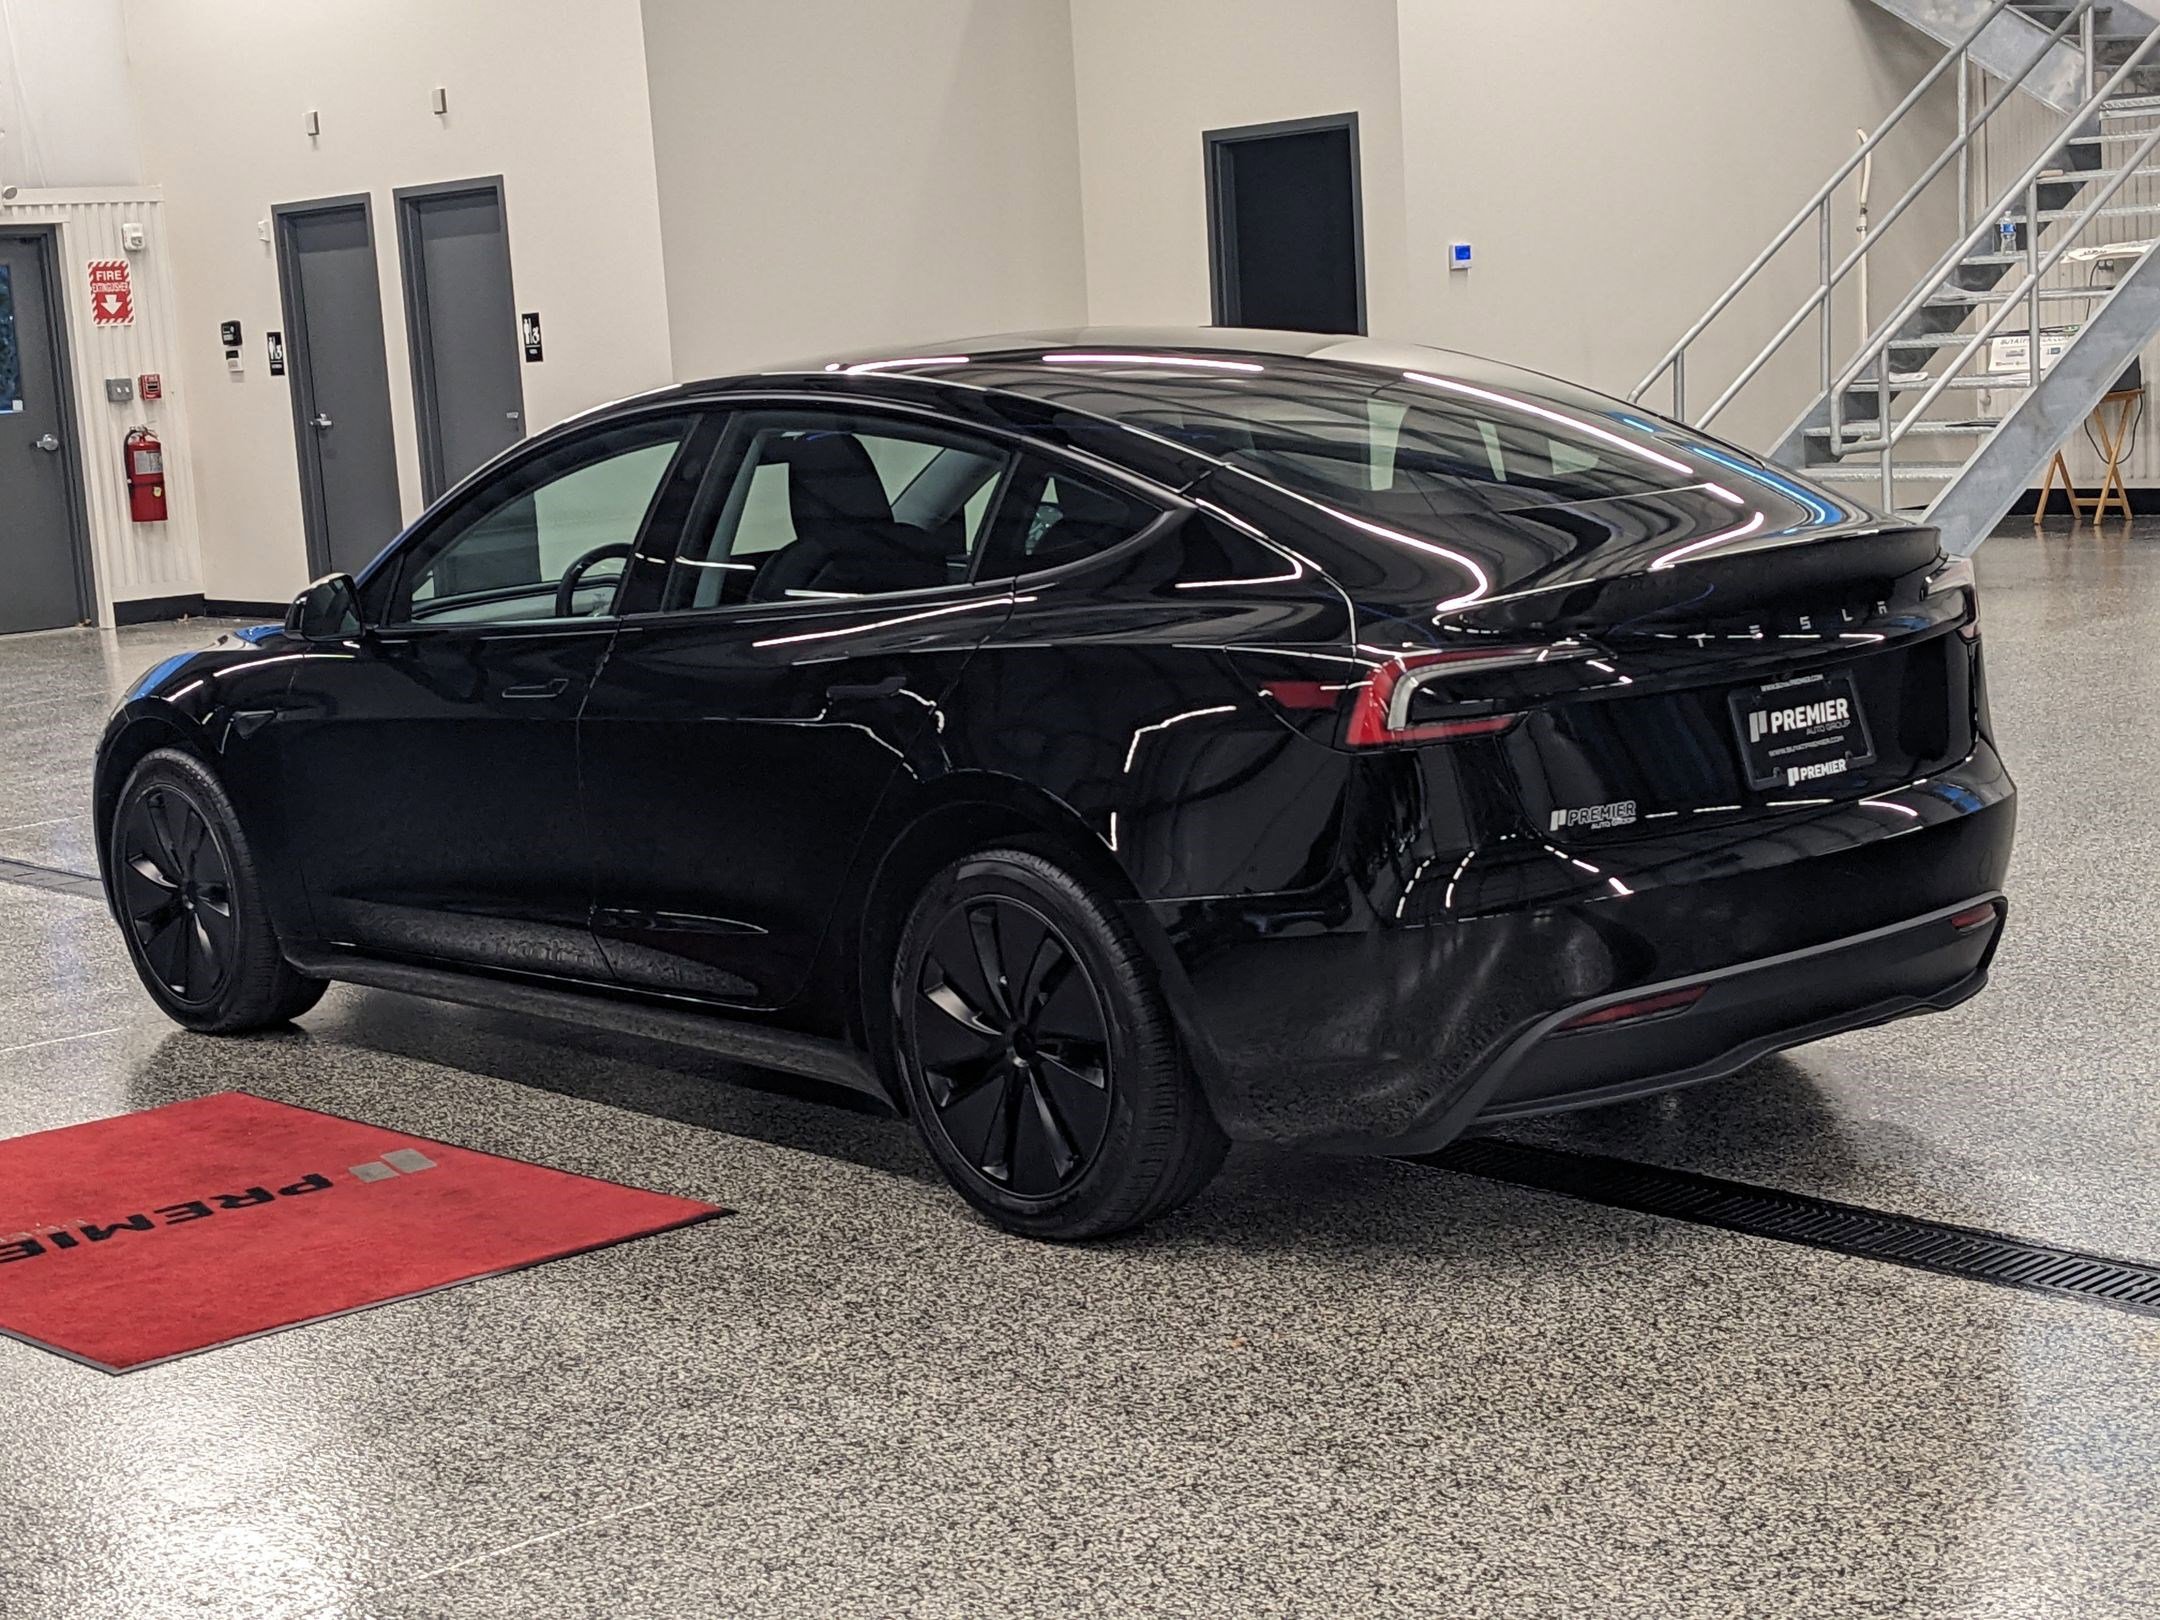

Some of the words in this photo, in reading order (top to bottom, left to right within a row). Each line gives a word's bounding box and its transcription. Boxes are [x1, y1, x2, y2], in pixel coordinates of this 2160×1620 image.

[95, 270, 123, 281] FIRE
[1770, 697, 1850, 734] PREMIER
[1806, 726, 1826, 736] AUTO
[1826, 719, 1851, 731] GROUP
[1800, 758, 1847, 781] PREMIER
[1567, 800, 1637, 827] PREMIER
